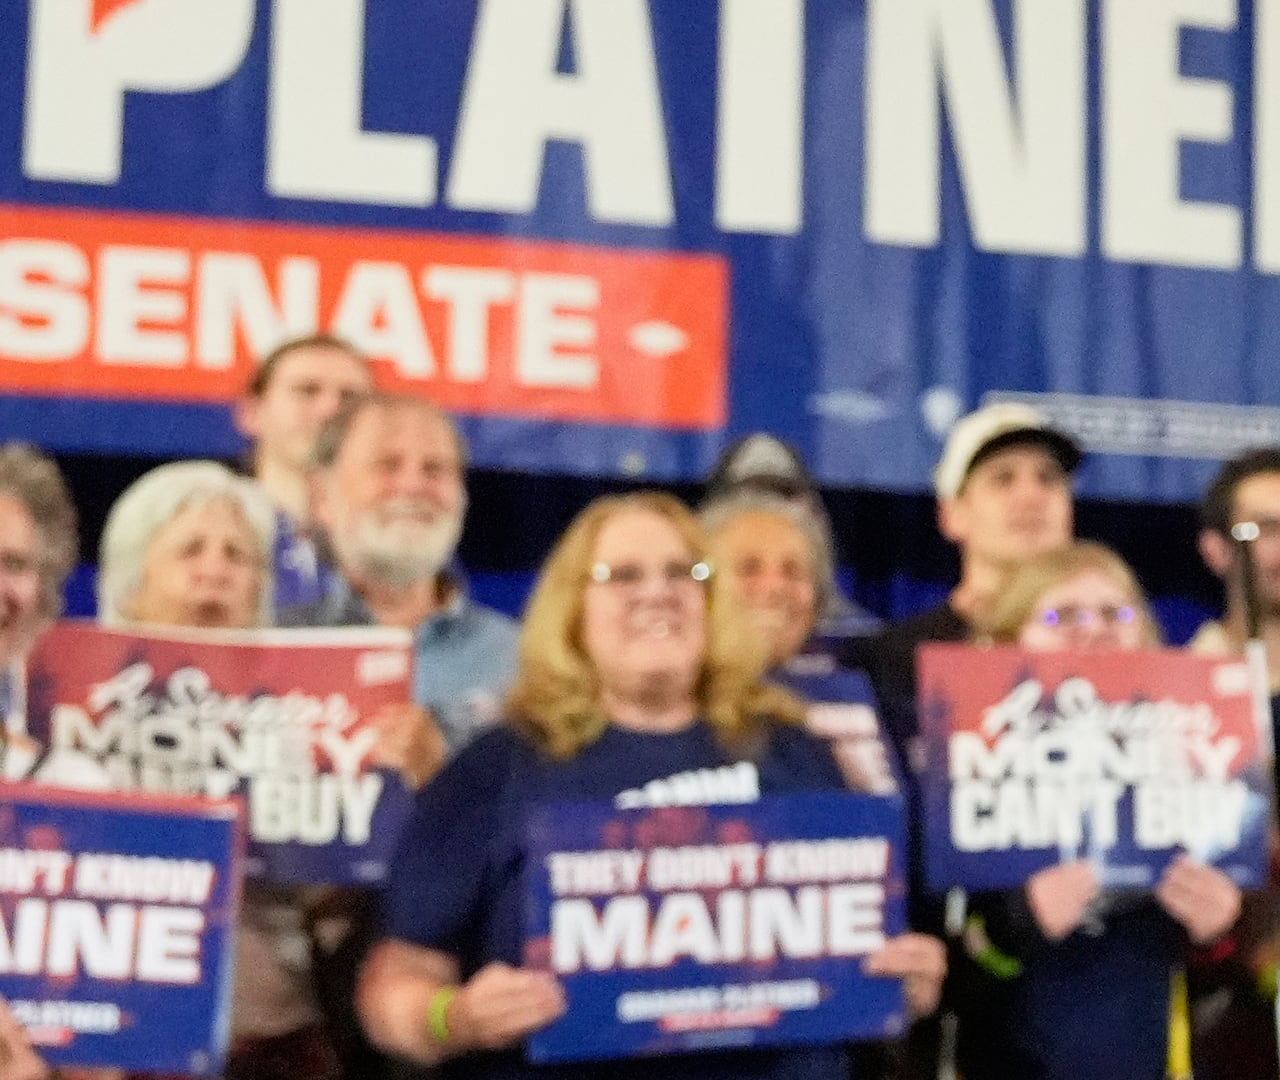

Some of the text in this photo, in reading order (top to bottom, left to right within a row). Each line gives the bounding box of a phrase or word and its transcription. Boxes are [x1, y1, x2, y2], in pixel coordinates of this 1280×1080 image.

[0, 237, 600, 391] SENATE
[247, 771, 386, 846] BUY
[548, 849, 645, 897] THEY
[0, 895, 204, 985] INE
[550, 882, 888, 974] MAINE
